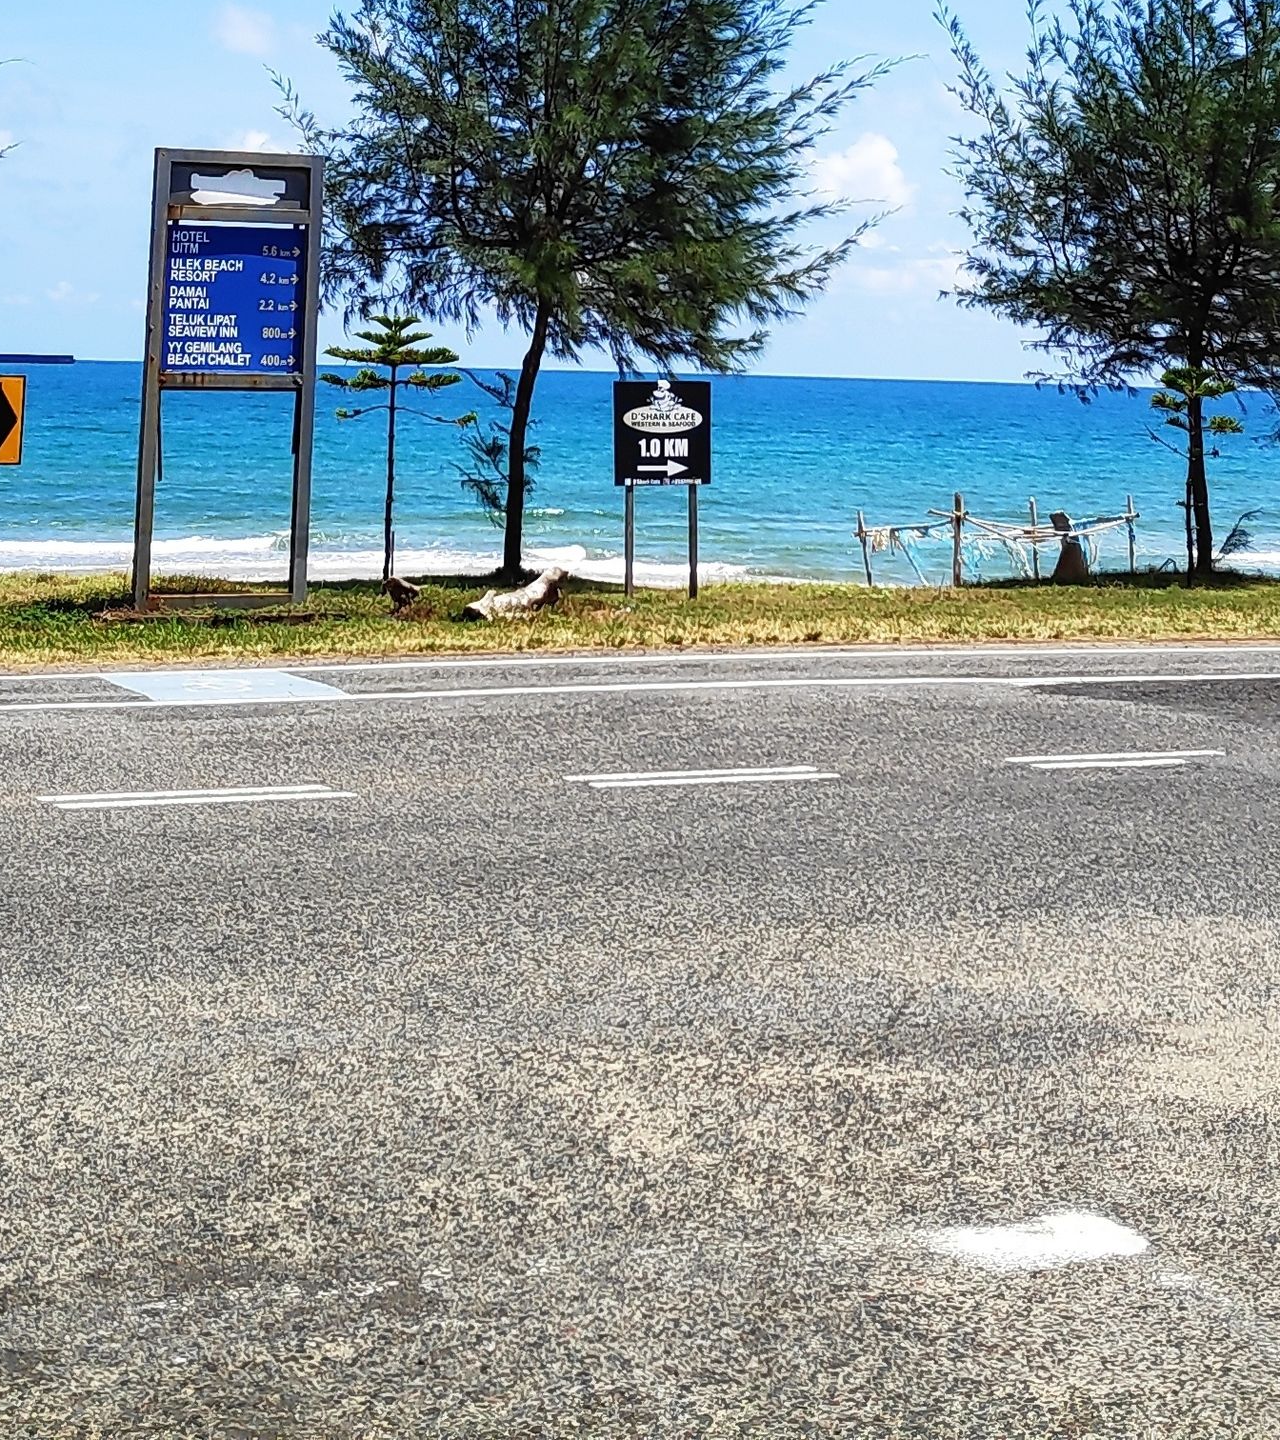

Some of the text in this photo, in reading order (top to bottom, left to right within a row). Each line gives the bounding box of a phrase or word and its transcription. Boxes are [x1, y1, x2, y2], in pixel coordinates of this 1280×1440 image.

[172, 230, 210, 242] HOTEL
[172, 242, 291, 257] UITM 5.6 km
[171, 258, 243, 271] ULEK BEACH
[170, 270, 289, 285] RESORT 4.2 km
[170, 285, 206, 297] DAMAI
[169, 297, 289, 311] PANTAI 2.2 km
[169, 313, 236, 326] TELUK LIPAT
[168, 325, 218, 337] SEAVIEW
[220, 326, 238, 338] INN
[168, 341, 242, 354] YY GEMILANG
[167, 353, 206, 365] BEACH
[208, 354, 251, 366] CHALET
[631, 412, 696, 421] D'SHARK CAFE
[638, 438, 689, 457] 1.0 KM
